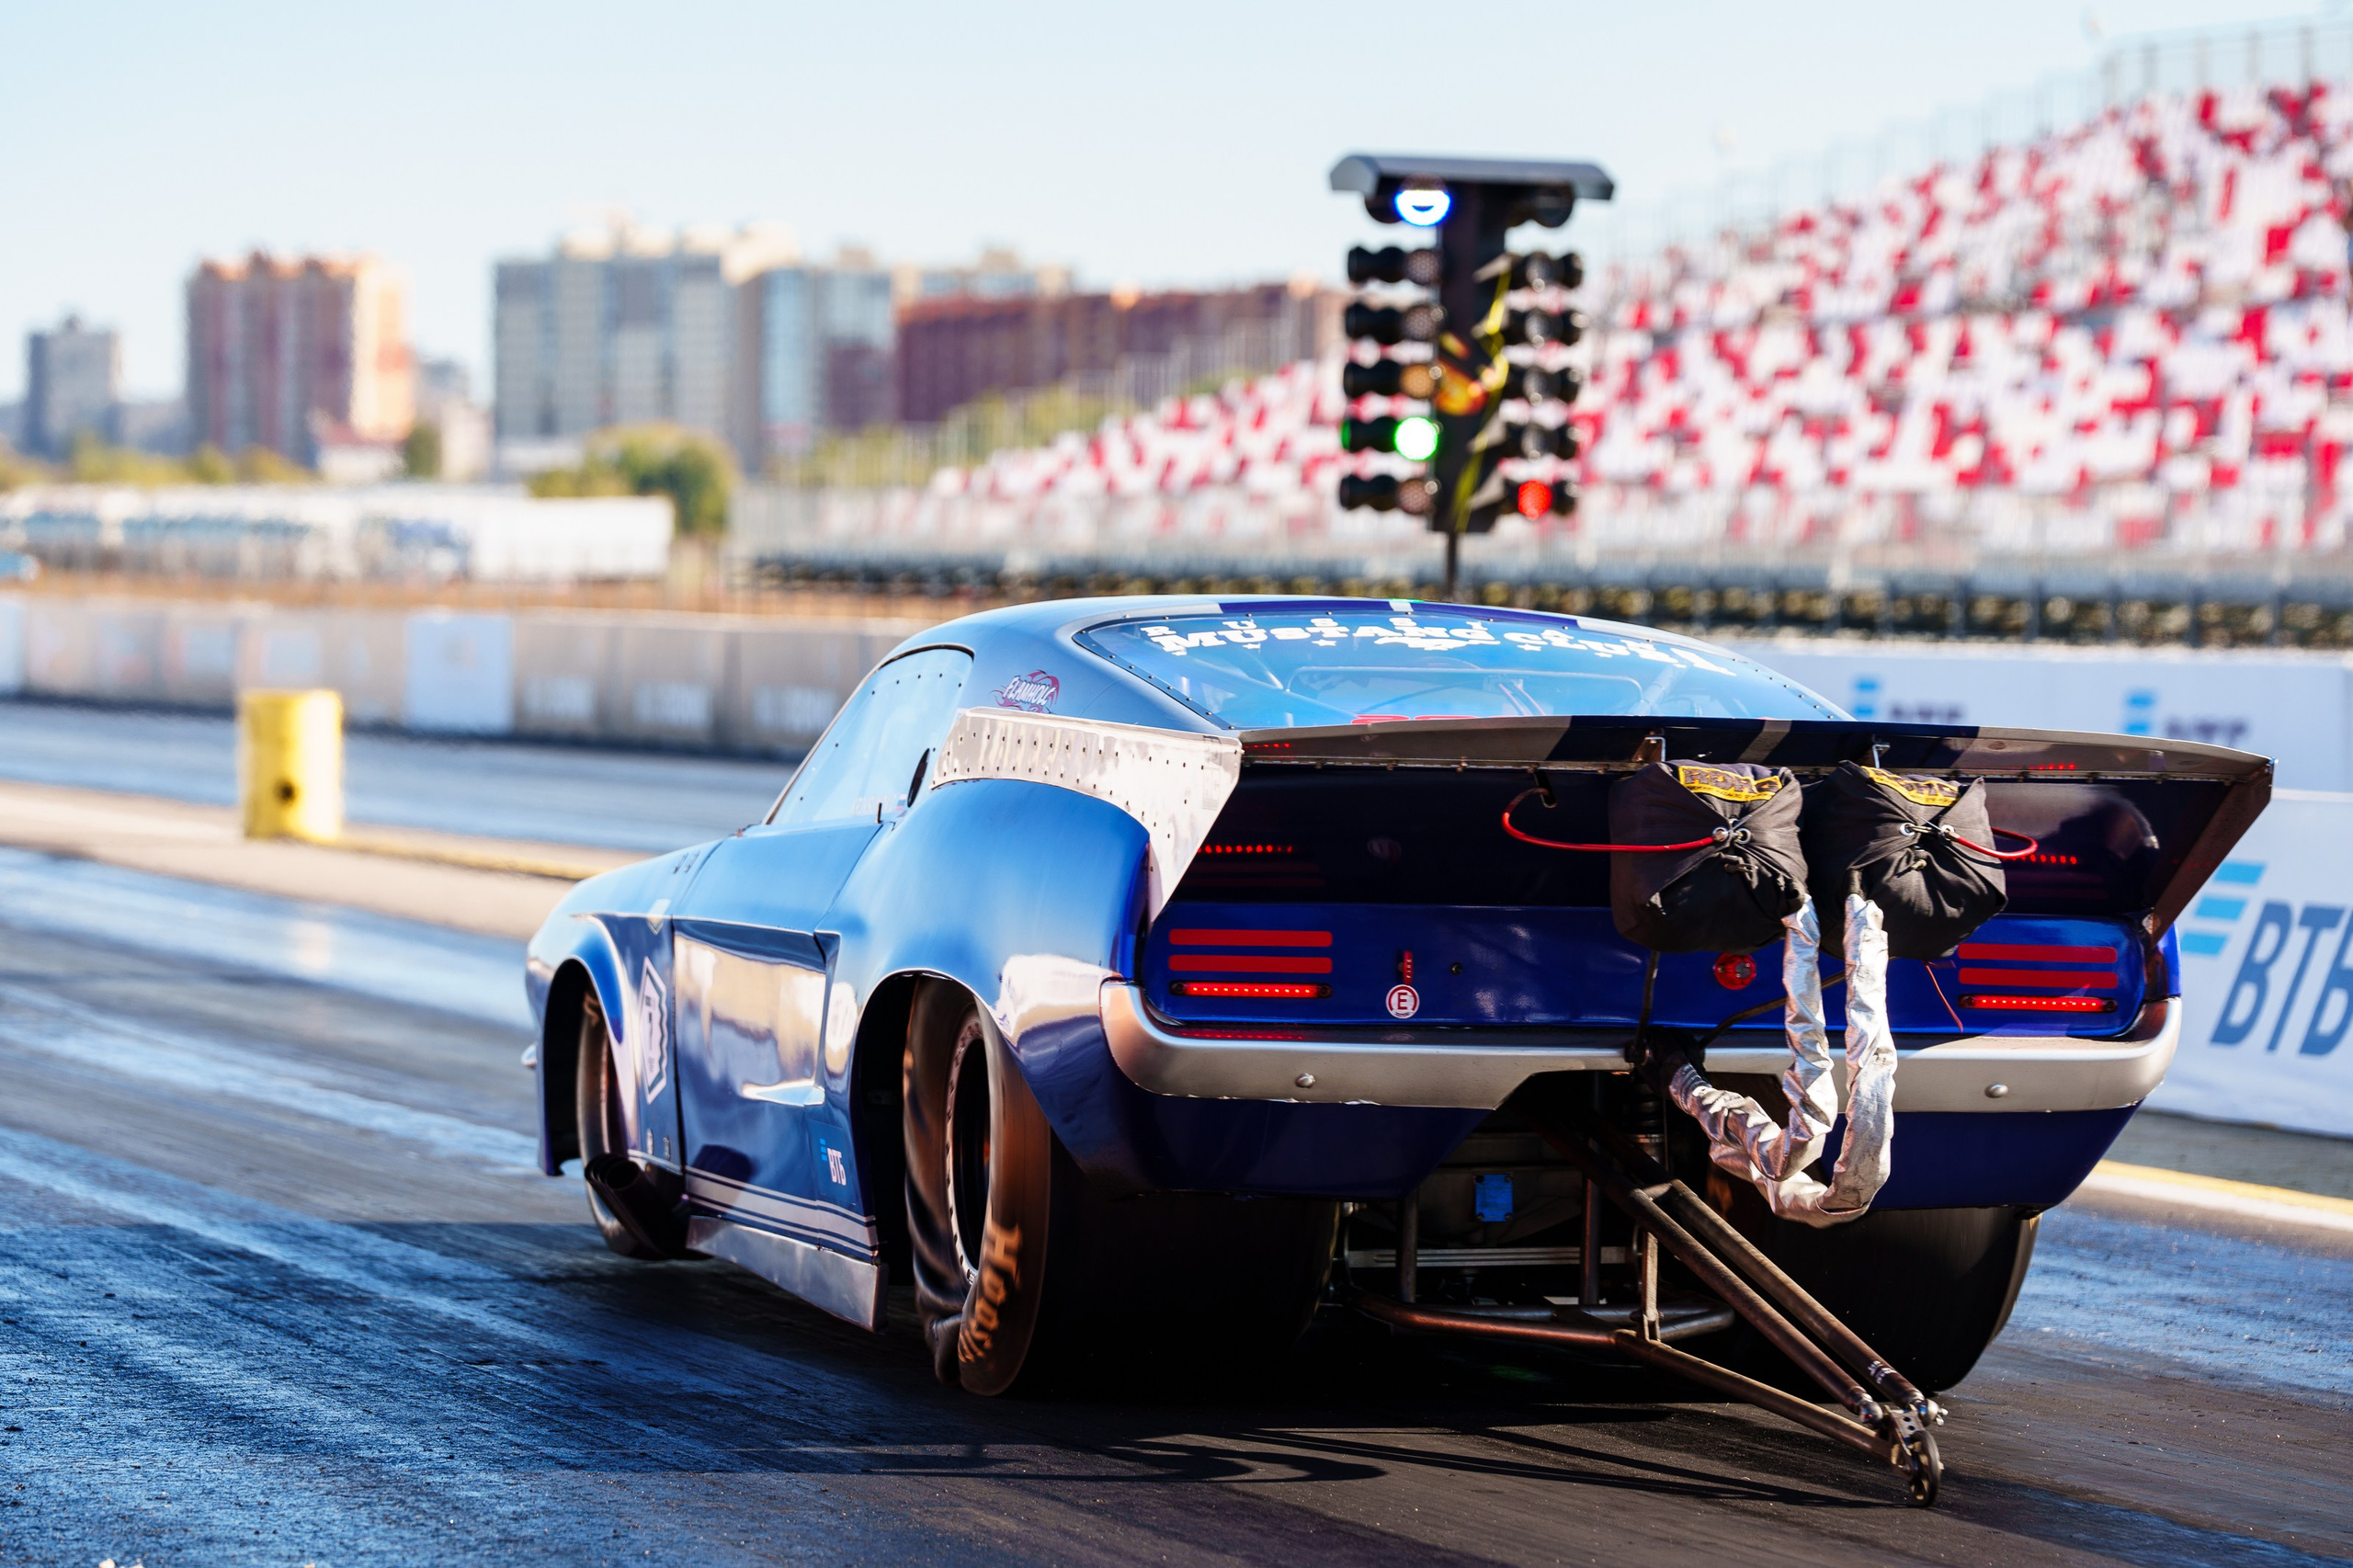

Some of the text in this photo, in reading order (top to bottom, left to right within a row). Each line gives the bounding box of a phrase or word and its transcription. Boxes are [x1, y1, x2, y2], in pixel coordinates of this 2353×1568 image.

[1151, 627, 1495, 653] MUSTANG
[1397, 992, 1407, 1010] E
[826, 1147, 847, 1186] ВТБ
